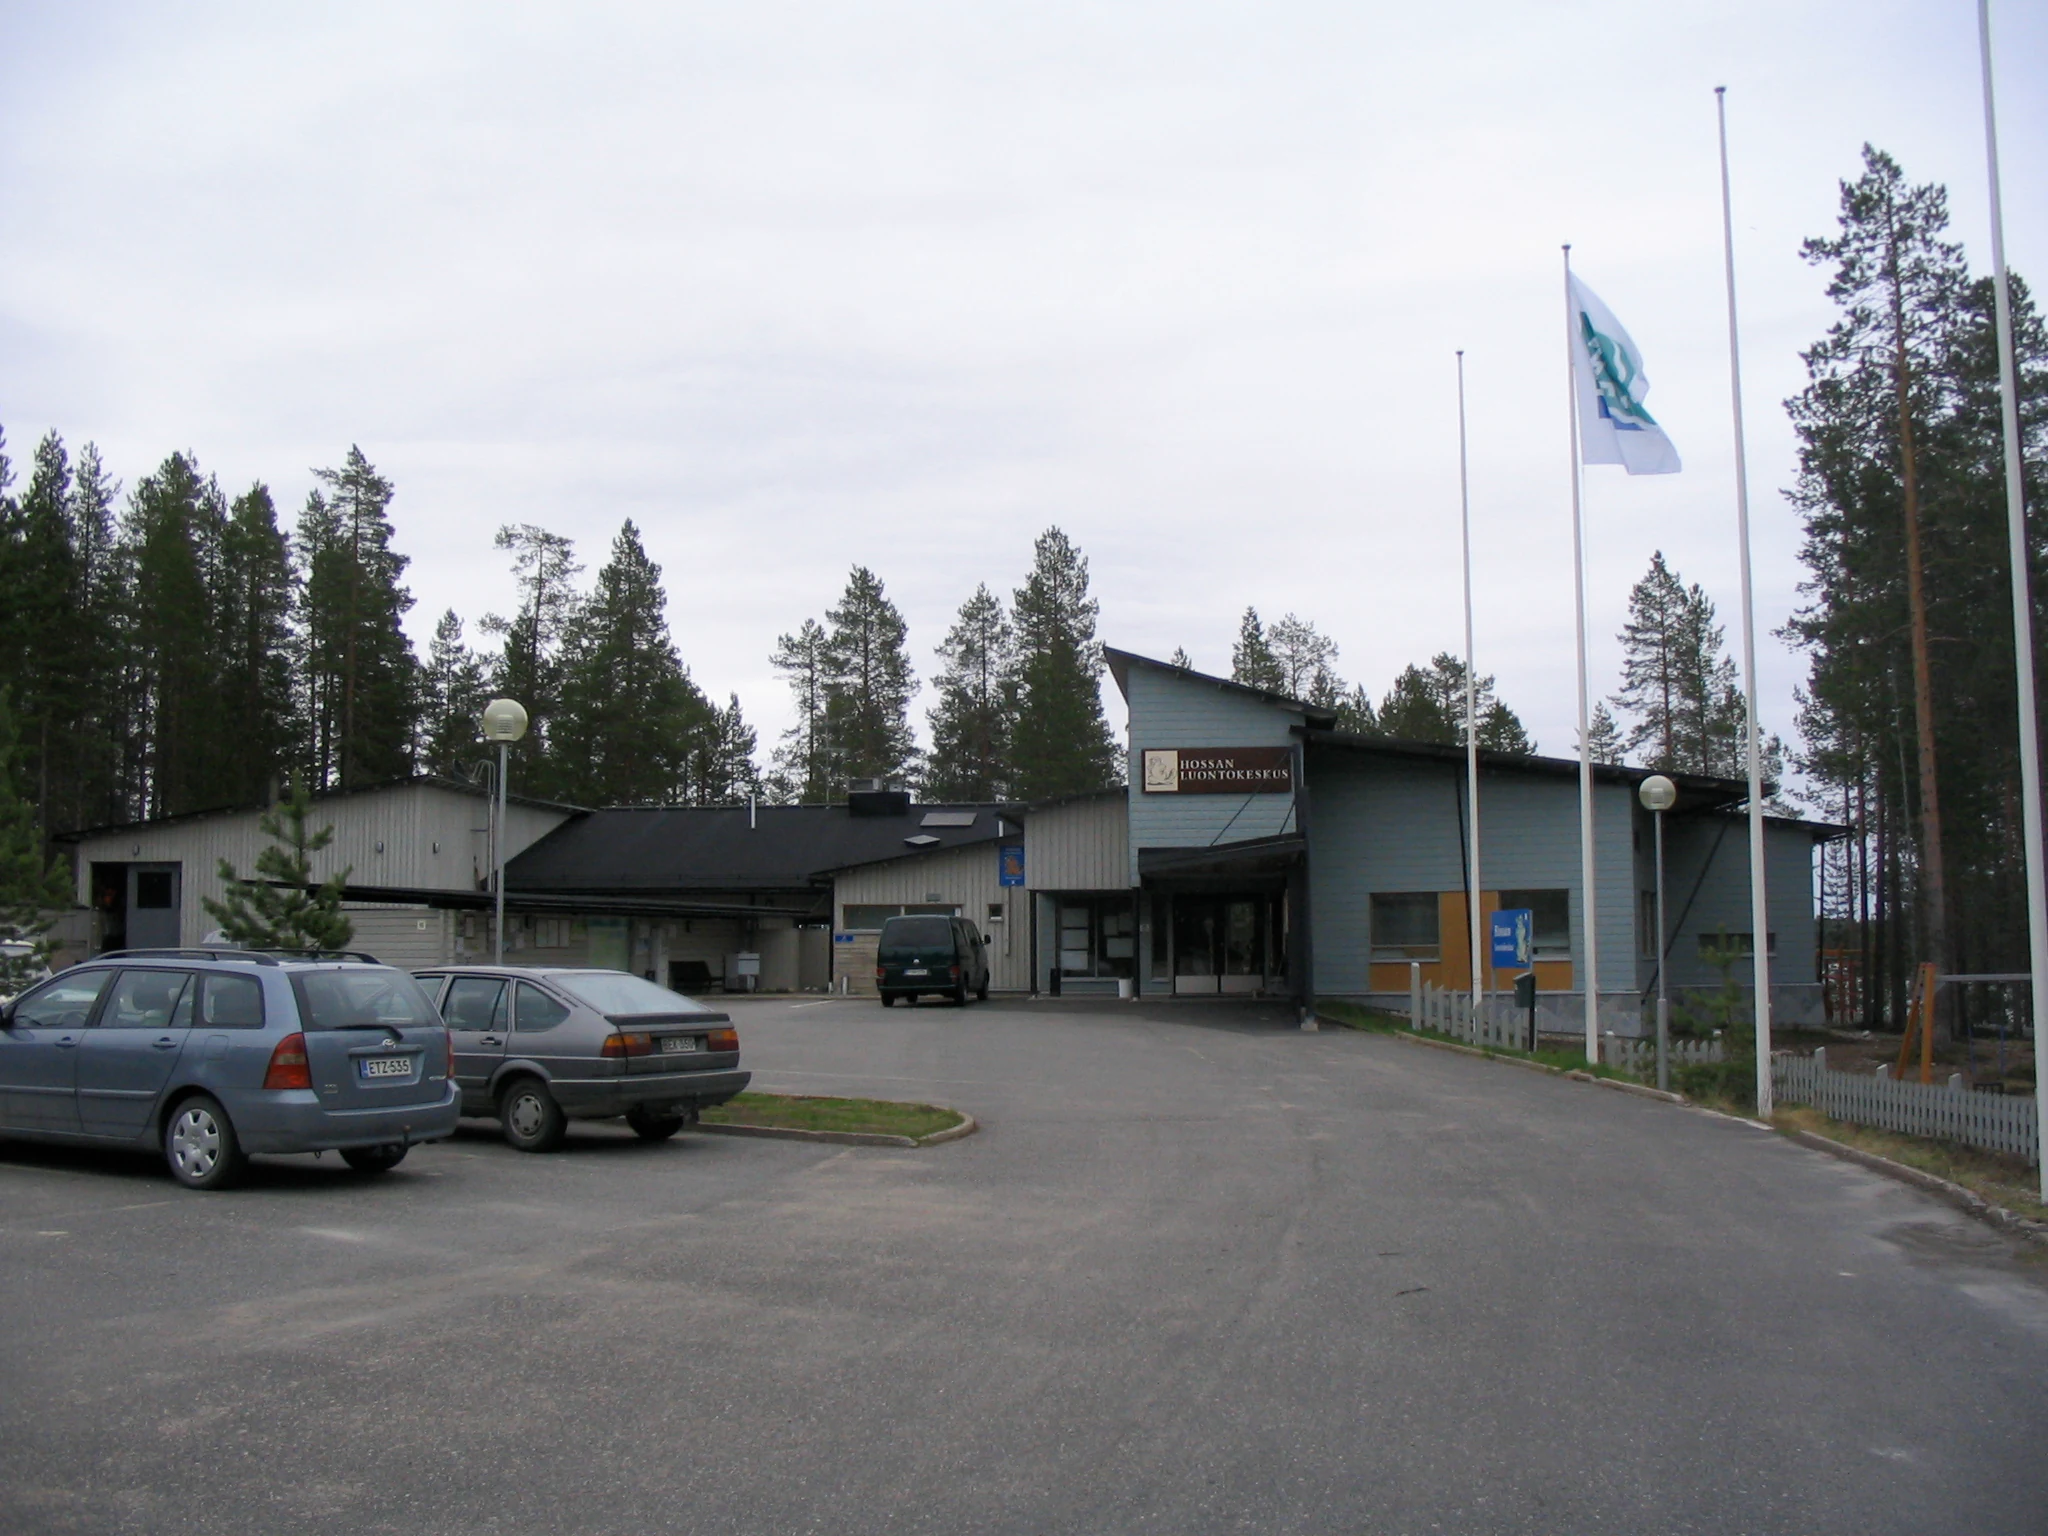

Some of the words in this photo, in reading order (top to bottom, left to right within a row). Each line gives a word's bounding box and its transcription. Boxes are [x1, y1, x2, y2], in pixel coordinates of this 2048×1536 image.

[1180, 759, 1234, 769] HOSSAN
[1180, 769, 1289, 781] LUONTOKESKUS
[368, 1060, 409, 1075] ETZ-535
